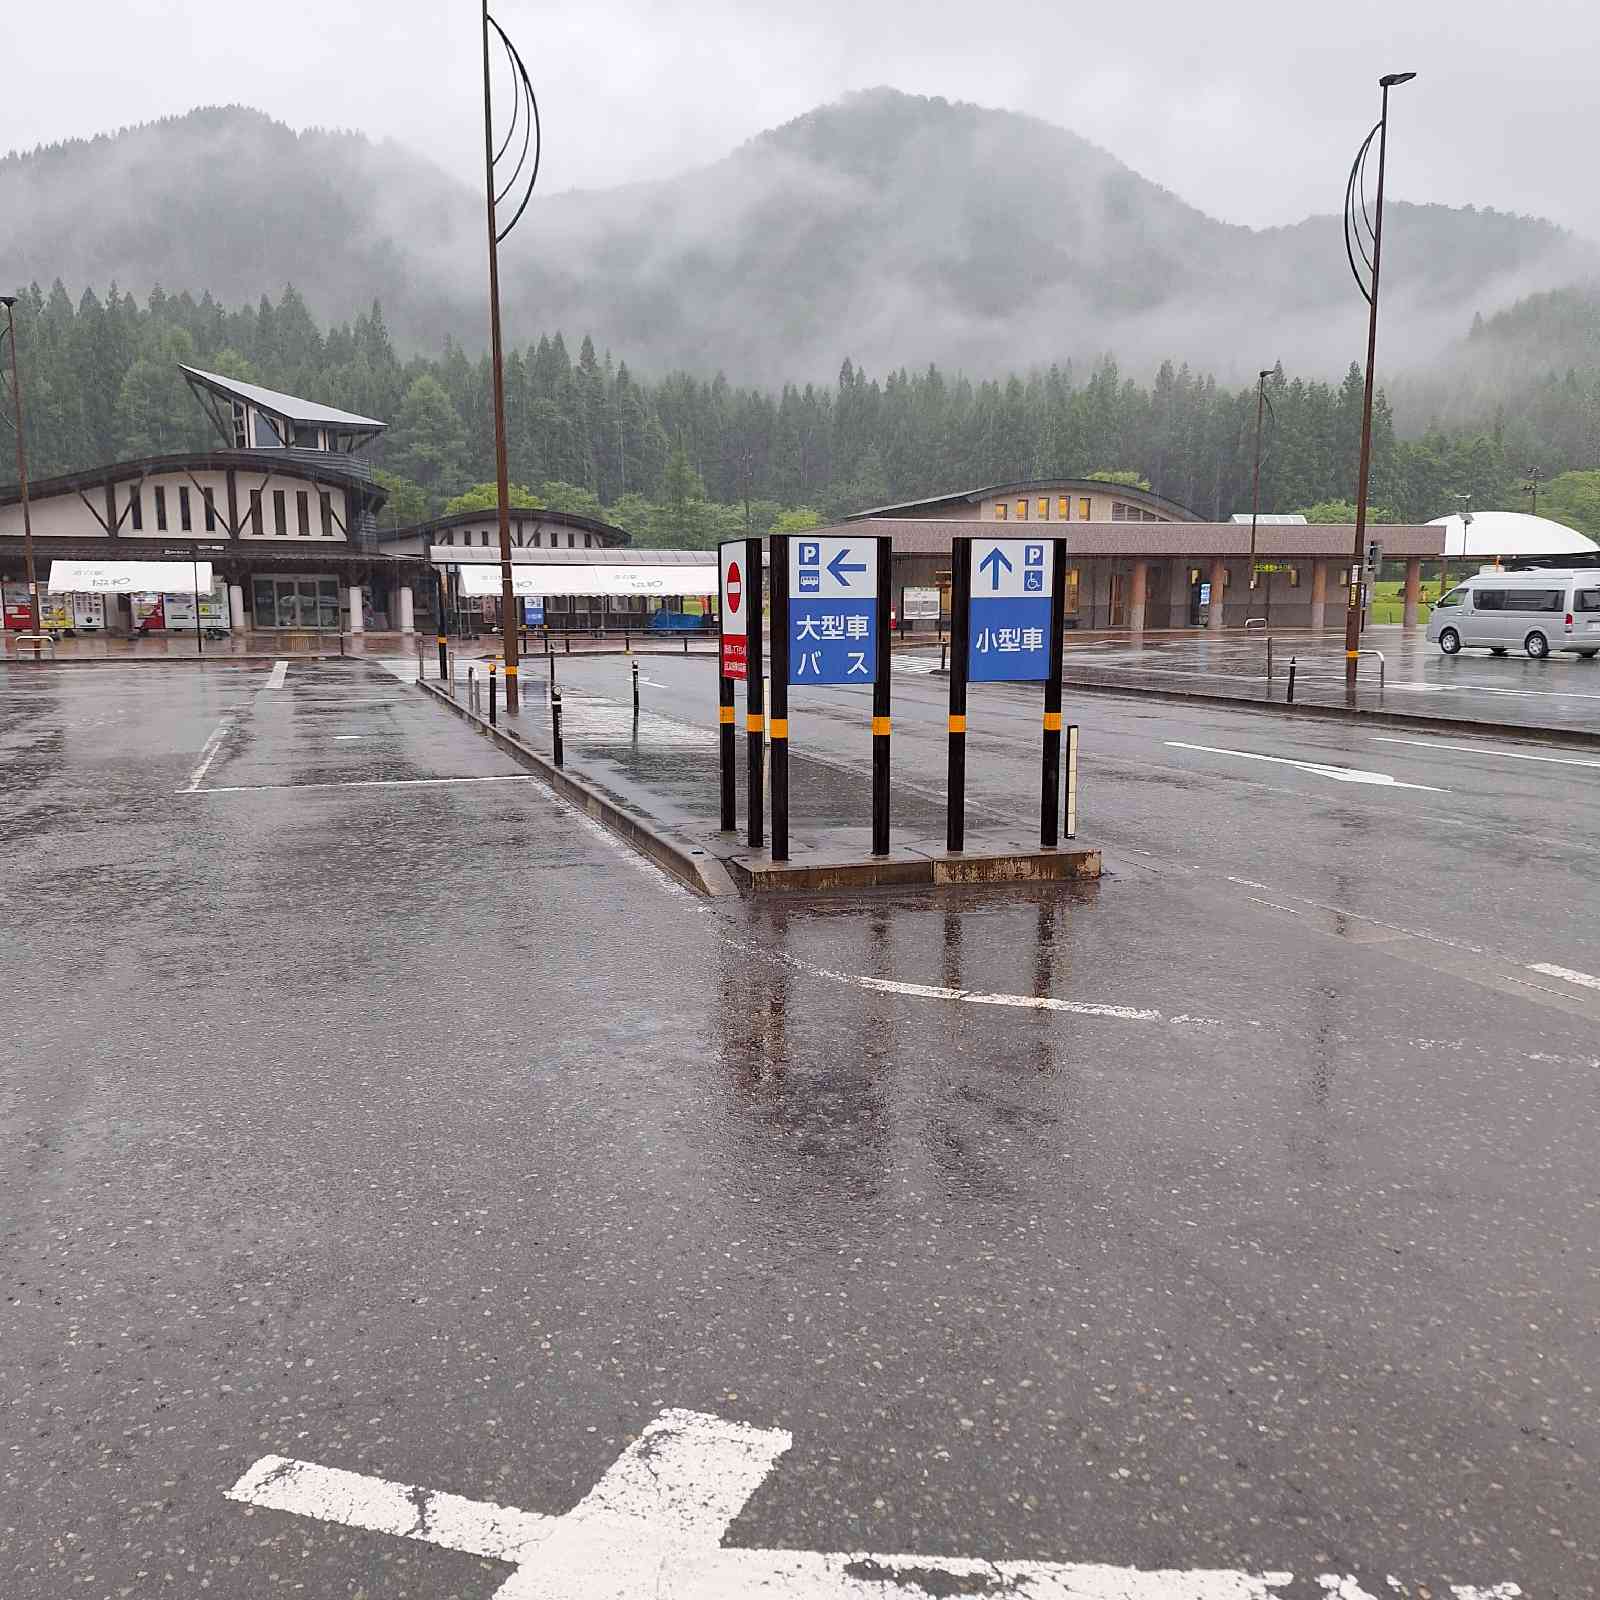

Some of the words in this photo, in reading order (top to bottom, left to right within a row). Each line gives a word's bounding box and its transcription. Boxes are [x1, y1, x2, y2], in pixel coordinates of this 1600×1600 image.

[804, 546, 817, 563] P
[1028, 548, 1041, 564] P
[796, 614, 870, 641] 大型車
[975, 627, 1044, 653] 小型車
